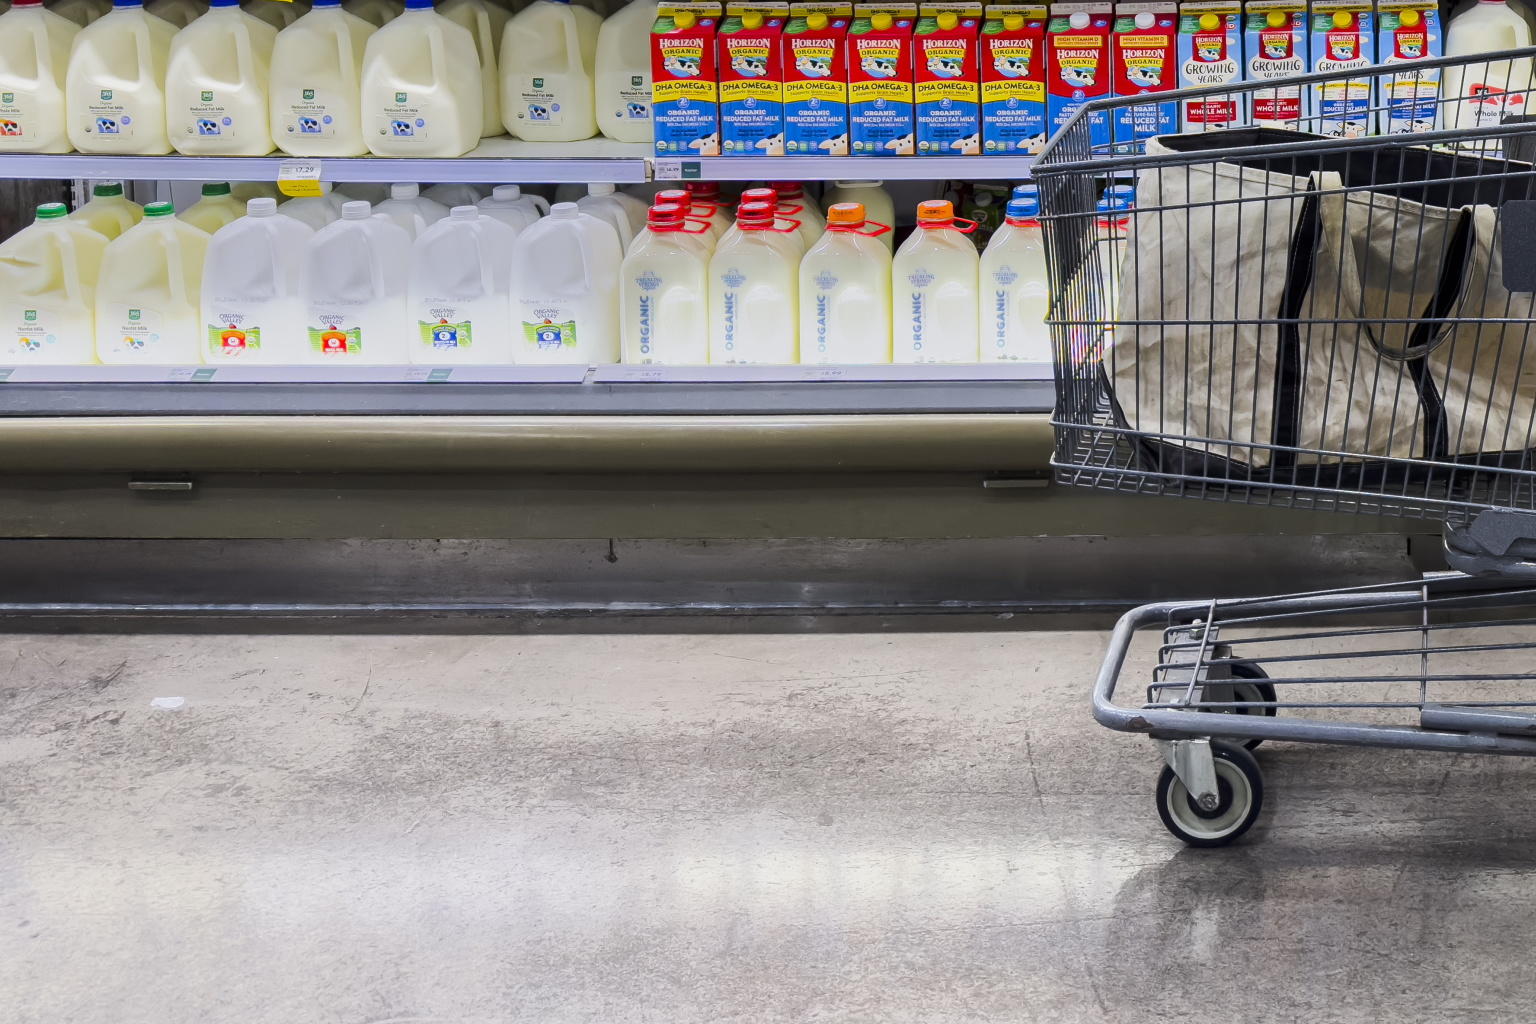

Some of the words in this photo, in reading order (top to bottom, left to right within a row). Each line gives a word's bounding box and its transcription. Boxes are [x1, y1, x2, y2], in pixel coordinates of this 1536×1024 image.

[660, 38, 704, 48] HORIZON
[857, 38, 900, 48] HORIZON
[1186, 62, 1233, 75] GROWING
[674, 82, 712, 92] OMEGA-3
[640, 295, 649, 354] ORGANIC
[913, 292, 922, 351] ORGANIC
